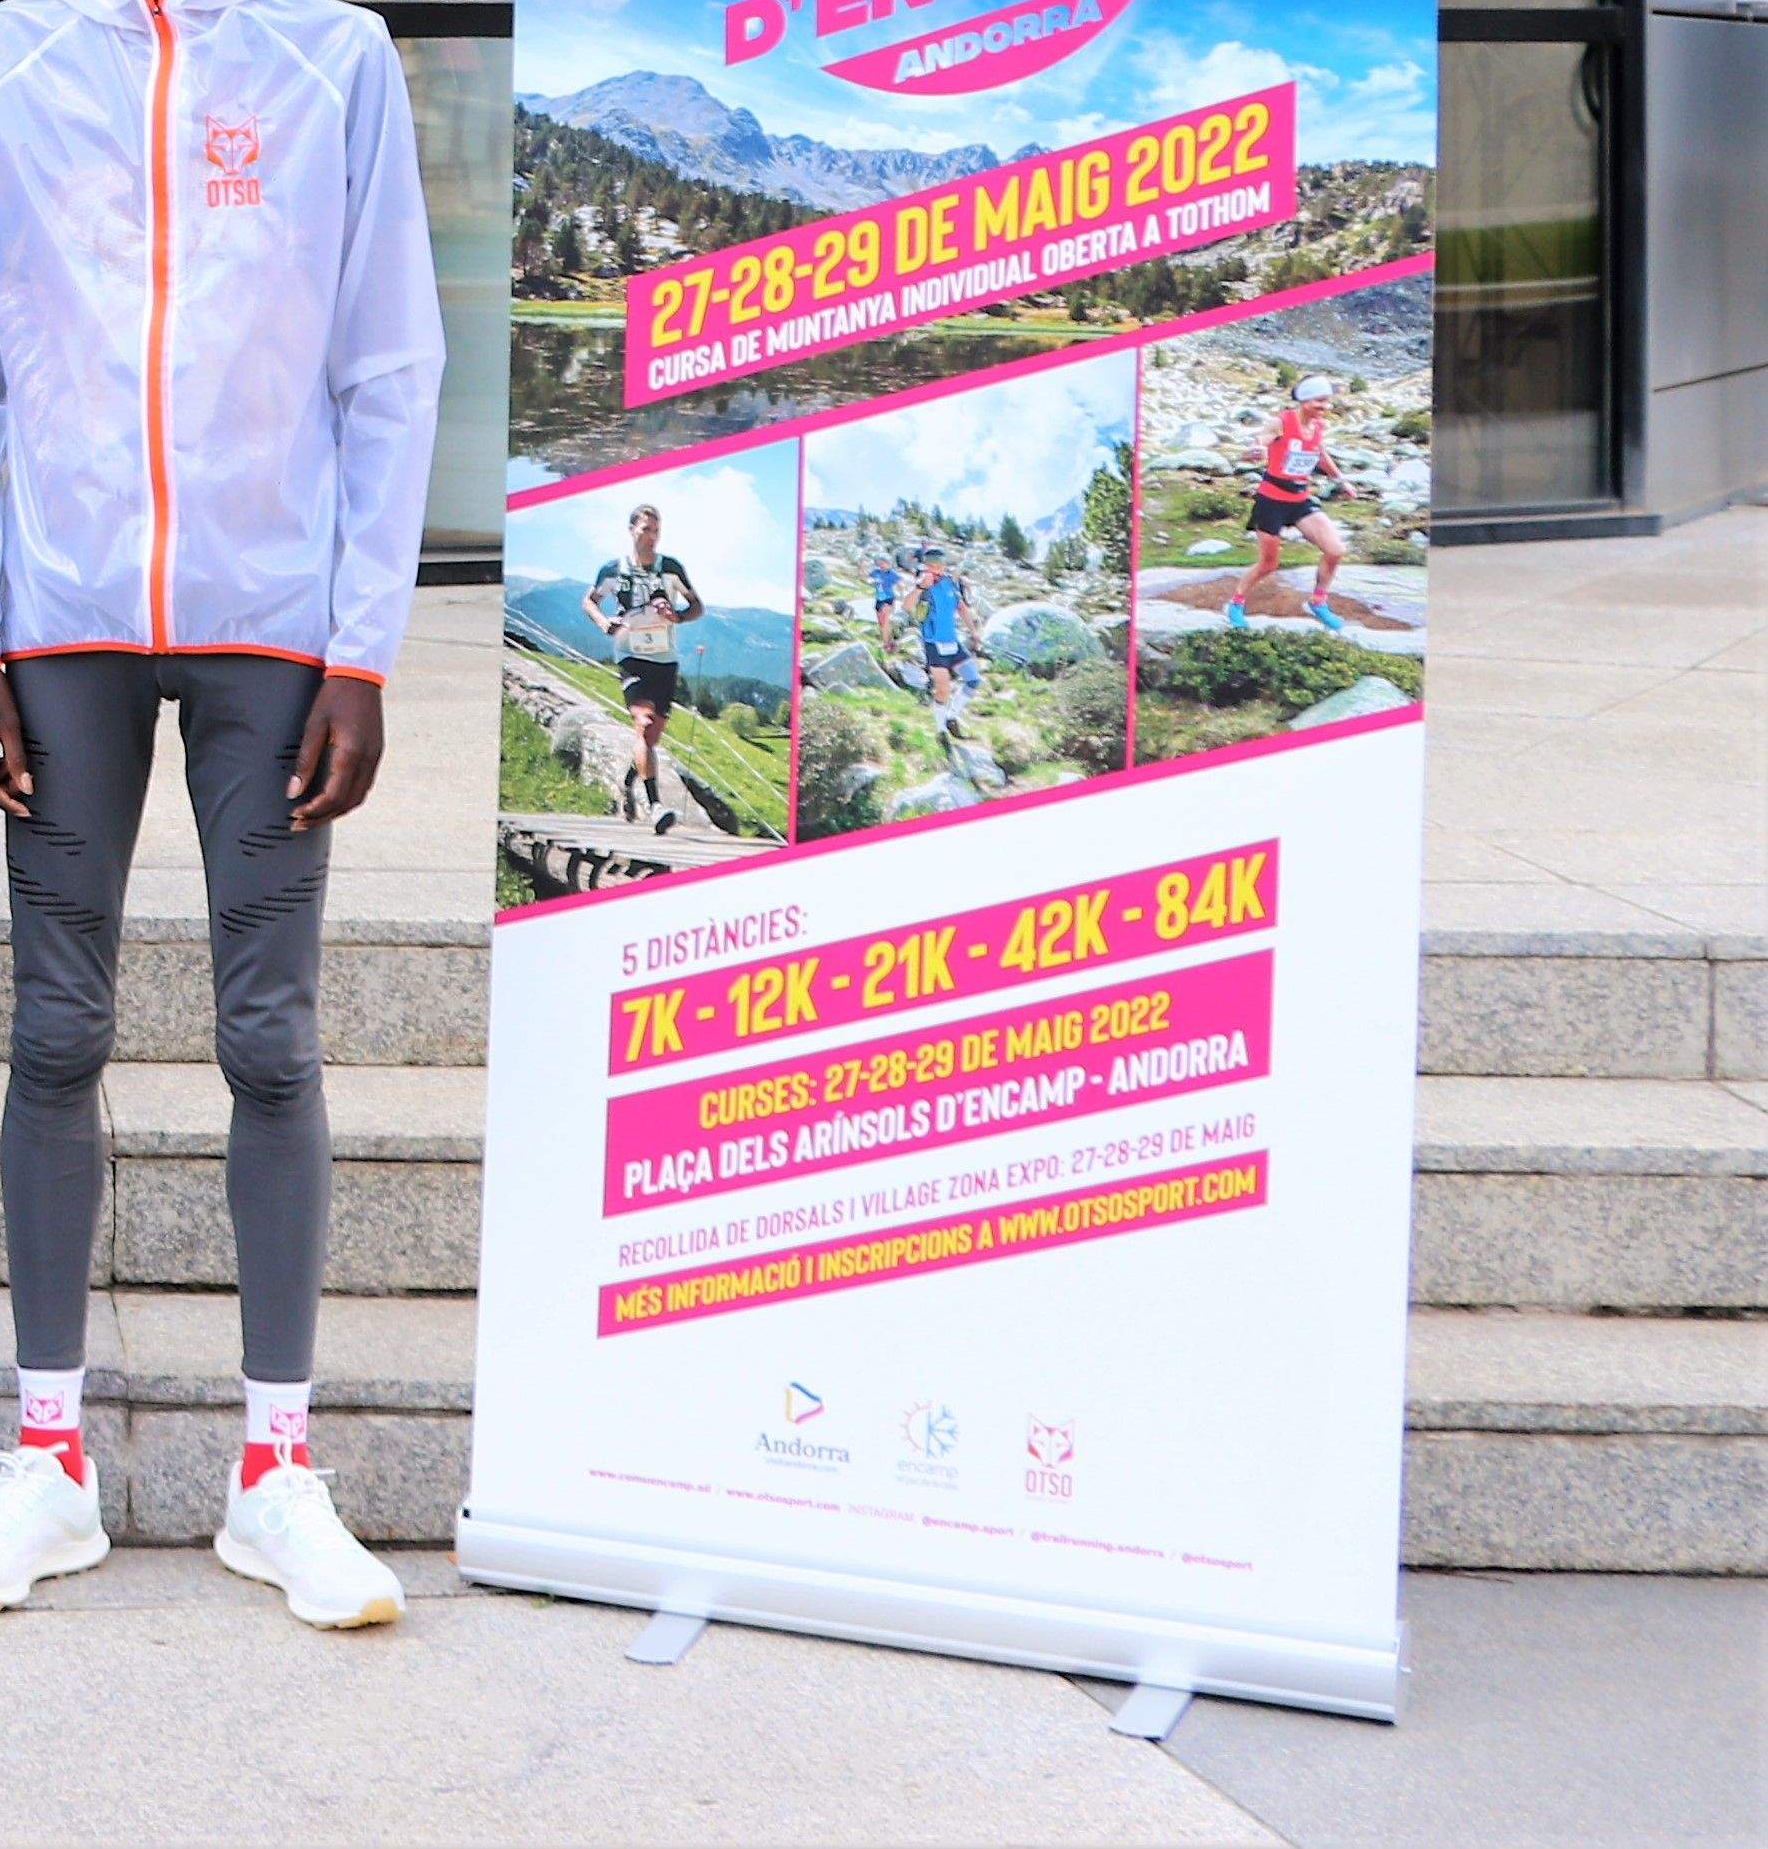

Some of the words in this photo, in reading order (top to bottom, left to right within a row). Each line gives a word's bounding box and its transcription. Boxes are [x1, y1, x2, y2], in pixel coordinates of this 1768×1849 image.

[206, 179, 261, 207] OTSO
[650, 218, 881, 349] 27-28-29
[894, 192, 960, 276] DE
[973, 150, 1113, 252] MAIG
[1124, 101, 1271, 207] 2022
[648, 335, 726, 390] CURSA
[730, 327, 762, 368] DE
[765, 296, 897, 360] MUNTANYA
[900, 263, 1037, 319] INDIVIDUAL
[1041, 232, 1137, 277] OBERTA
[1141, 225, 1162, 249] A
[1166, 181, 1271, 241] TOTHOM
[621, 940, 639, 976] 5
[645, 903, 810, 970] DISTÀNCIES:
[621, 986, 685, 1064] 7K
[727, 955, 821, 1039] 12K
[862, 924, 958, 1011] 21K
[999, 888, 1111, 974] 42K
[1153, 851, 1267, 941] 84K
[623, 1150, 714, 1199] PLAÇA
[718, 1131, 788, 1181] DELS
[793, 1096, 931, 1166] ARÍNSOLS
[935, 1066, 1087, 1142] D'ENCAMP
[1107, 1029, 1249, 1096] ANDORRA
[697, 1069, 818, 1131] CURSES:
[823, 1039, 955, 1104] 27-28-29
[960, 1032, 1001, 1073] DE
[1006, 1009, 1084, 1064] MAIG
[1088, 988, 1171, 1043] 2022
[614, 1283, 663, 1323] MÉS
[666, 1255, 801, 1314] INFORMACIÓ
[817, 1224, 973, 1283] INSCRIPCIONS
[976, 1220, 995, 1251] A
[999, 1164, 1257, 1246] WWW.OTSOSPORT.COM
[618, 1229, 721, 1269] RECOLLIDA
[725, 1220, 751, 1246] DE
[755, 1199, 844, 1240] DORSALS
[861, 1177, 941, 1217] VILLAGE
[948, 1168, 1001, 1202] ZONA
[1006, 1154, 1065, 1190] EXPO:
[1070, 1134, 1164, 1174] 27-28-29
[1169, 1126, 1196, 1153] DE
[1200, 1112, 1257, 1147] MAIG
[754, 1432, 851, 1464] Andorra
[1024, 1468, 1073, 1498] OTSO
